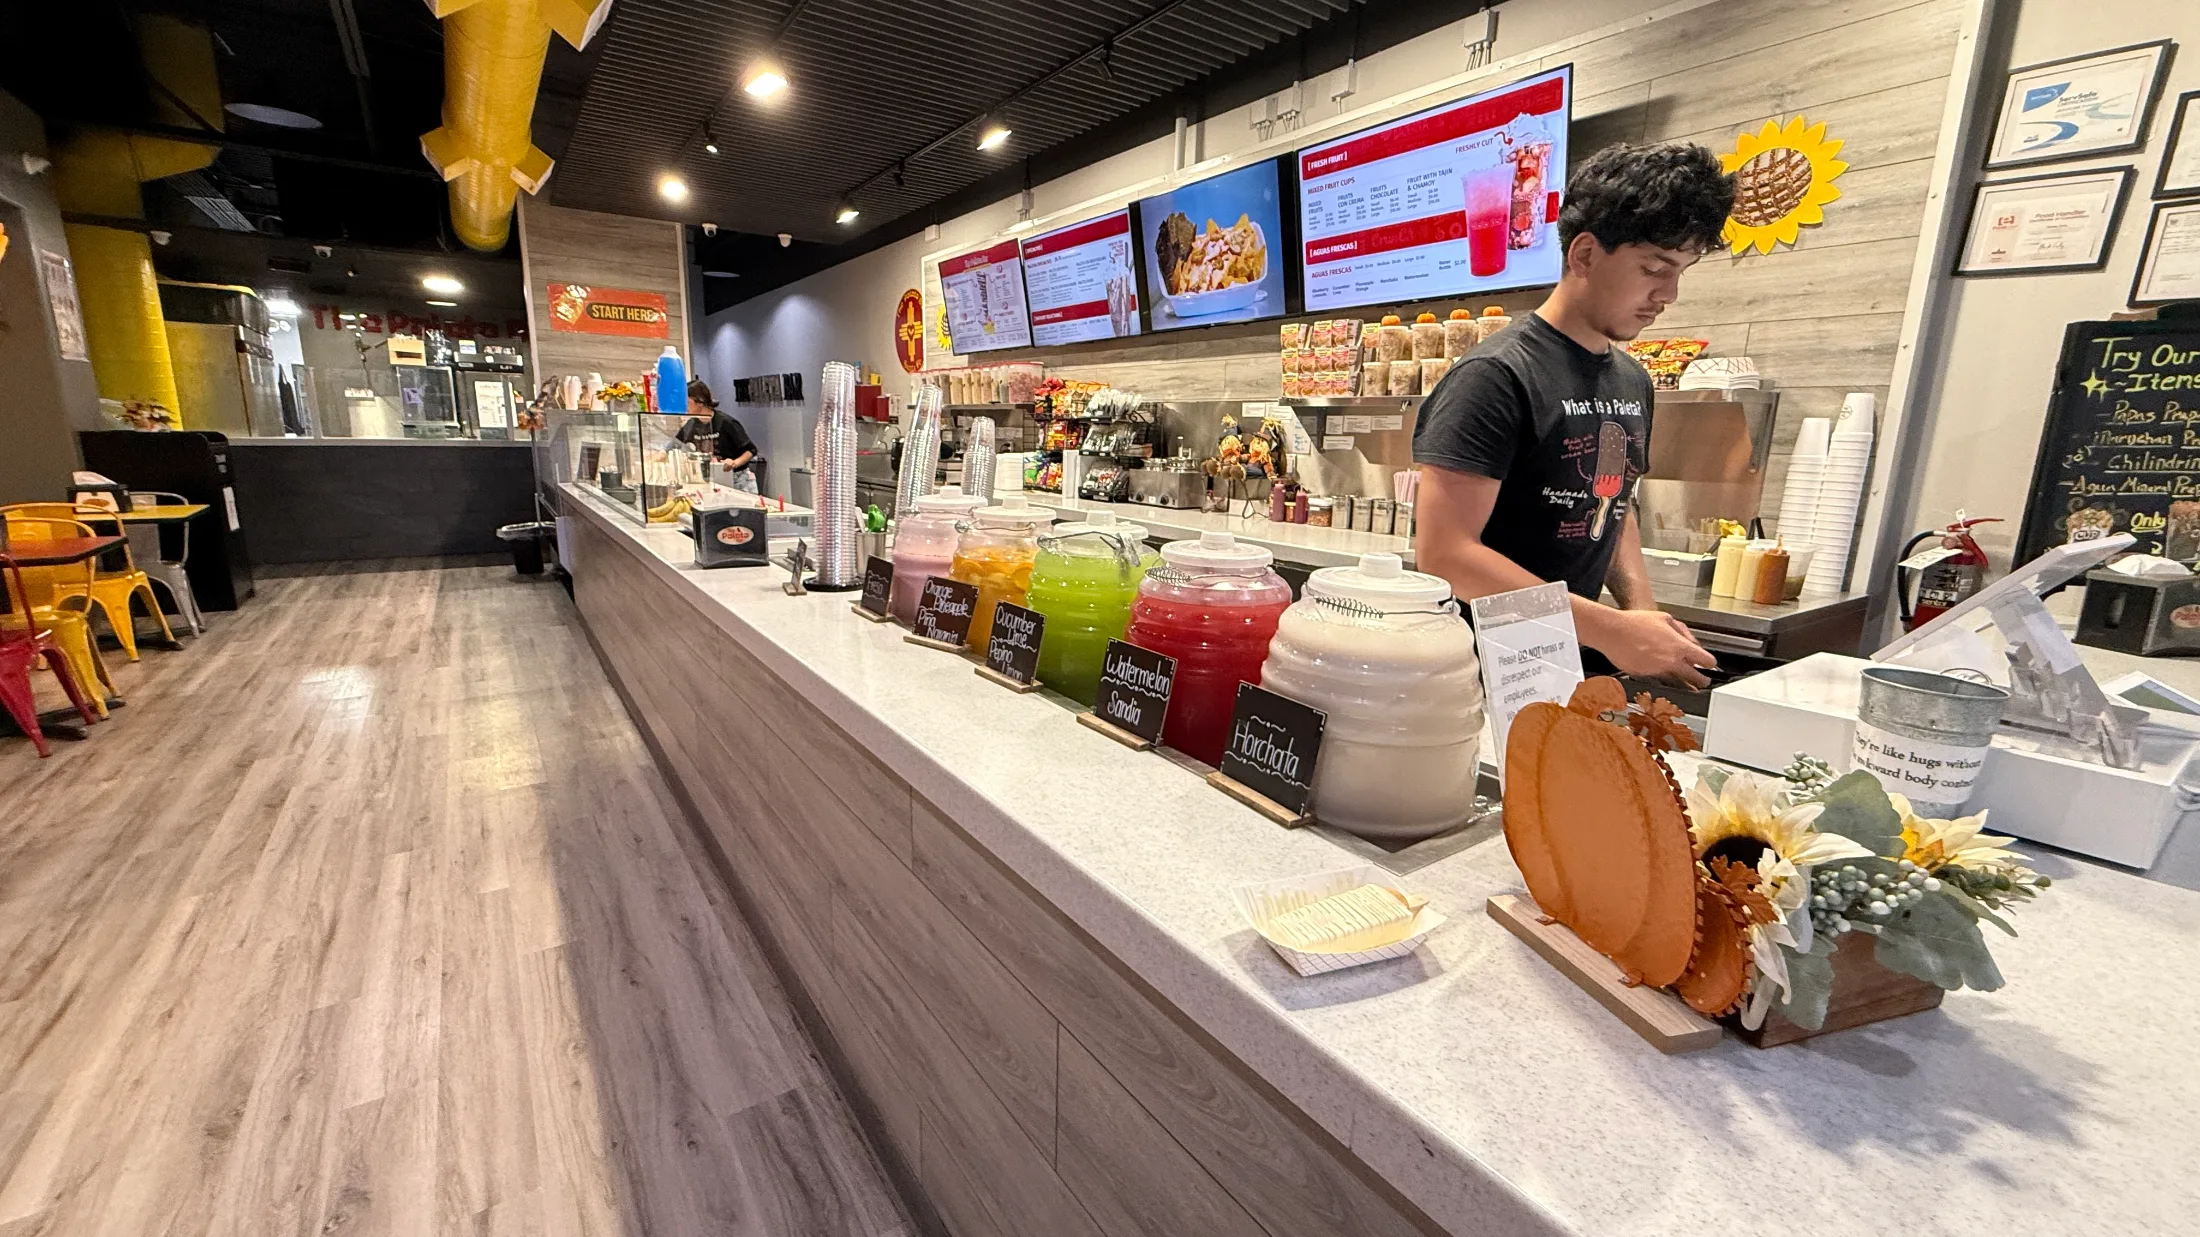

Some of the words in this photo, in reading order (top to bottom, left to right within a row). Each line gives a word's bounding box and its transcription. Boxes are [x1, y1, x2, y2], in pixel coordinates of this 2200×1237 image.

[1455, 141, 1480, 154] FRESHLY
[1481, 138, 1493, 147] CUT
[1325, 181, 1340, 191] FRUIT
[1341, 177, 1355, 187] CUPS
[1407, 176, 1422, 184] FRUIT
[1422, 172, 1437, 181] WITH
[1438, 168, 1453, 177] TAJIN
[1413, 180, 1436, 191] CHAMOY
[1370, 184, 1388, 193] FRUITS
[1370, 188, 1399, 201] CHOCOLATE
[1312, 270, 1328, 278] AGUAS
[1329, 266, 1352, 275] FRESCAS
[592, 304, 625, 320] START
[626, 308, 655, 322] HERE
[2092, 337, 2141, 371] Try
[2151, 344, 2200, 366] Our
[1562, 398, 1593, 416] What
[1594, 397, 1605, 414] is
[1606, 403, 1613, 415] a
[1613, 398, 1641, 416] Paleta?
[1542, 487, 1588, 499] Handmade
[1549, 496, 1575, 509] Daily
[2131, 511, 2167, 530] Only
[721, 531, 750, 540] Paleta
[2075, 529, 2100, 541] CUP
[925, 580, 954, 599] Orange
[934, 598, 969, 617] Pineapple
[918, 608, 937, 627] Piña
[996, 606, 1036, 635] Cucumber
[1007, 628, 1028, 649] Lime
[989, 640, 1013, 664] Pepino
[1498, 654, 1517, 667] Please
[1517, 650, 1528, 662] DO
[1528, 645, 1541, 658] NOT
[1541, 643, 1558, 655] harass
[1558, 641, 1565, 650] or
[1106, 654, 1170, 695] Watermelon
[1501, 668, 1531, 686] disrespect
[1531, 666, 1543, 677] our
[1107, 691, 1141, 726] Sandia
[1232, 722, 1300, 779] Horchata
[1882, 744, 1906, 760] like
[1909, 751, 1942, 770] hugs
[1904, 770, 1939, 789] body
